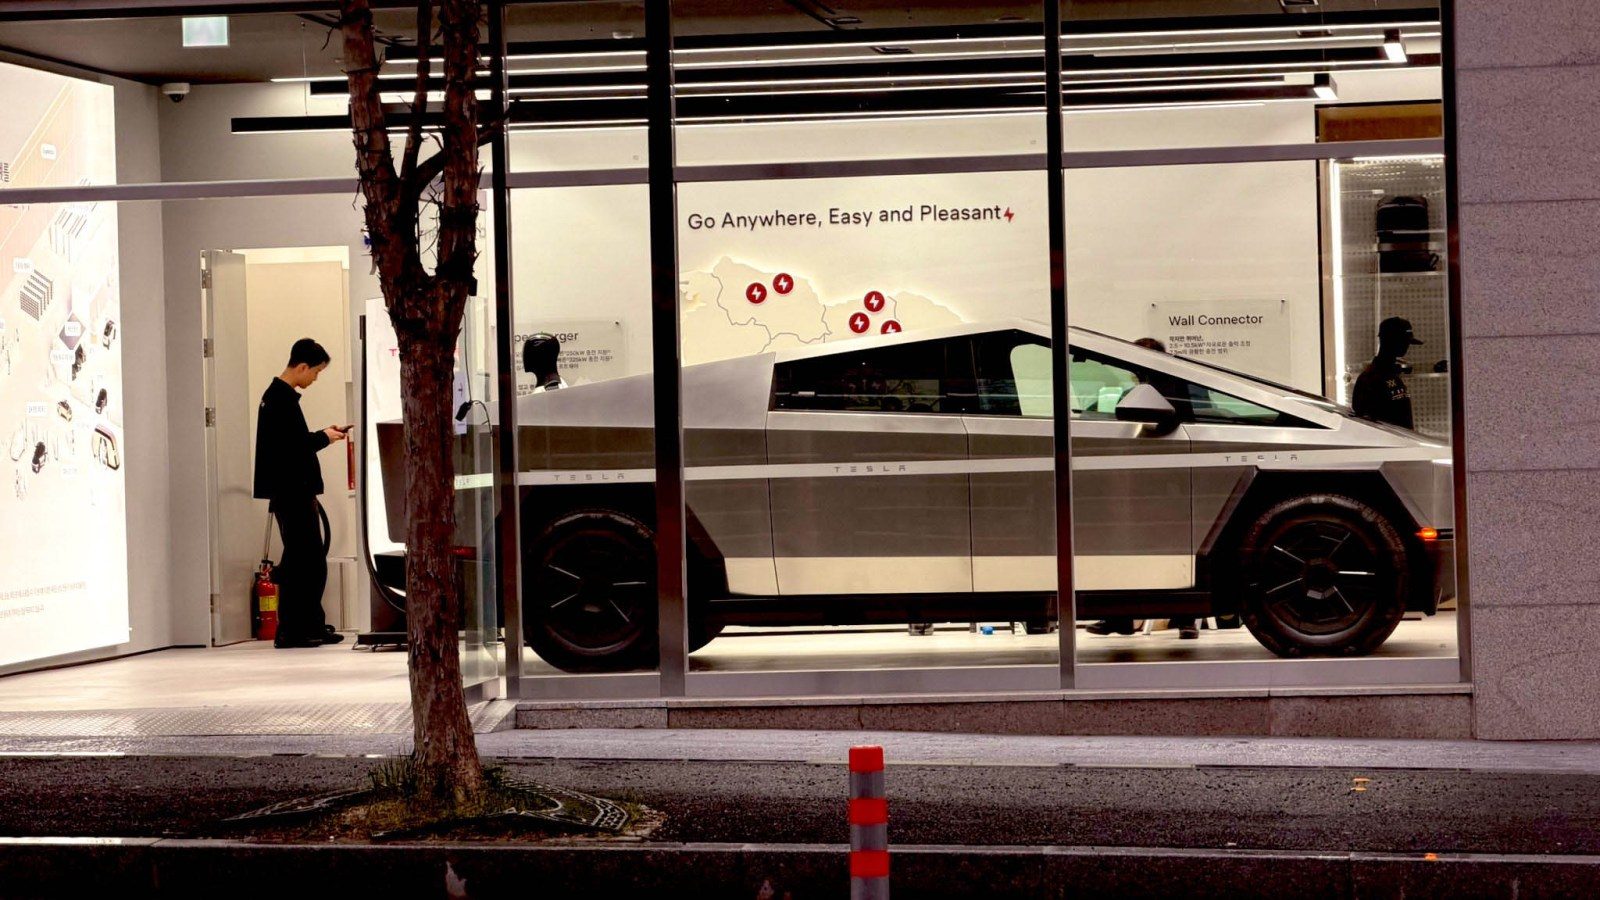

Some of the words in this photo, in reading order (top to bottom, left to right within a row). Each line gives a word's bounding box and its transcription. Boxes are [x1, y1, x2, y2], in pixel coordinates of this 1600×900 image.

[688, 213, 715, 230] Go
[721, 209, 822, 232] Anywhere,
[829, 208, 873, 227] Easy
[878, 205, 913, 222] and
[920, 203, 1001, 221] Pleasant
[1168, 315, 1195, 326] Wall
[1198, 314, 1264, 326] Connector
[1224, 454, 1298, 462] TESLA
[834, 464, 906, 473] TESLA
[553, 472, 625, 481] TESLA
